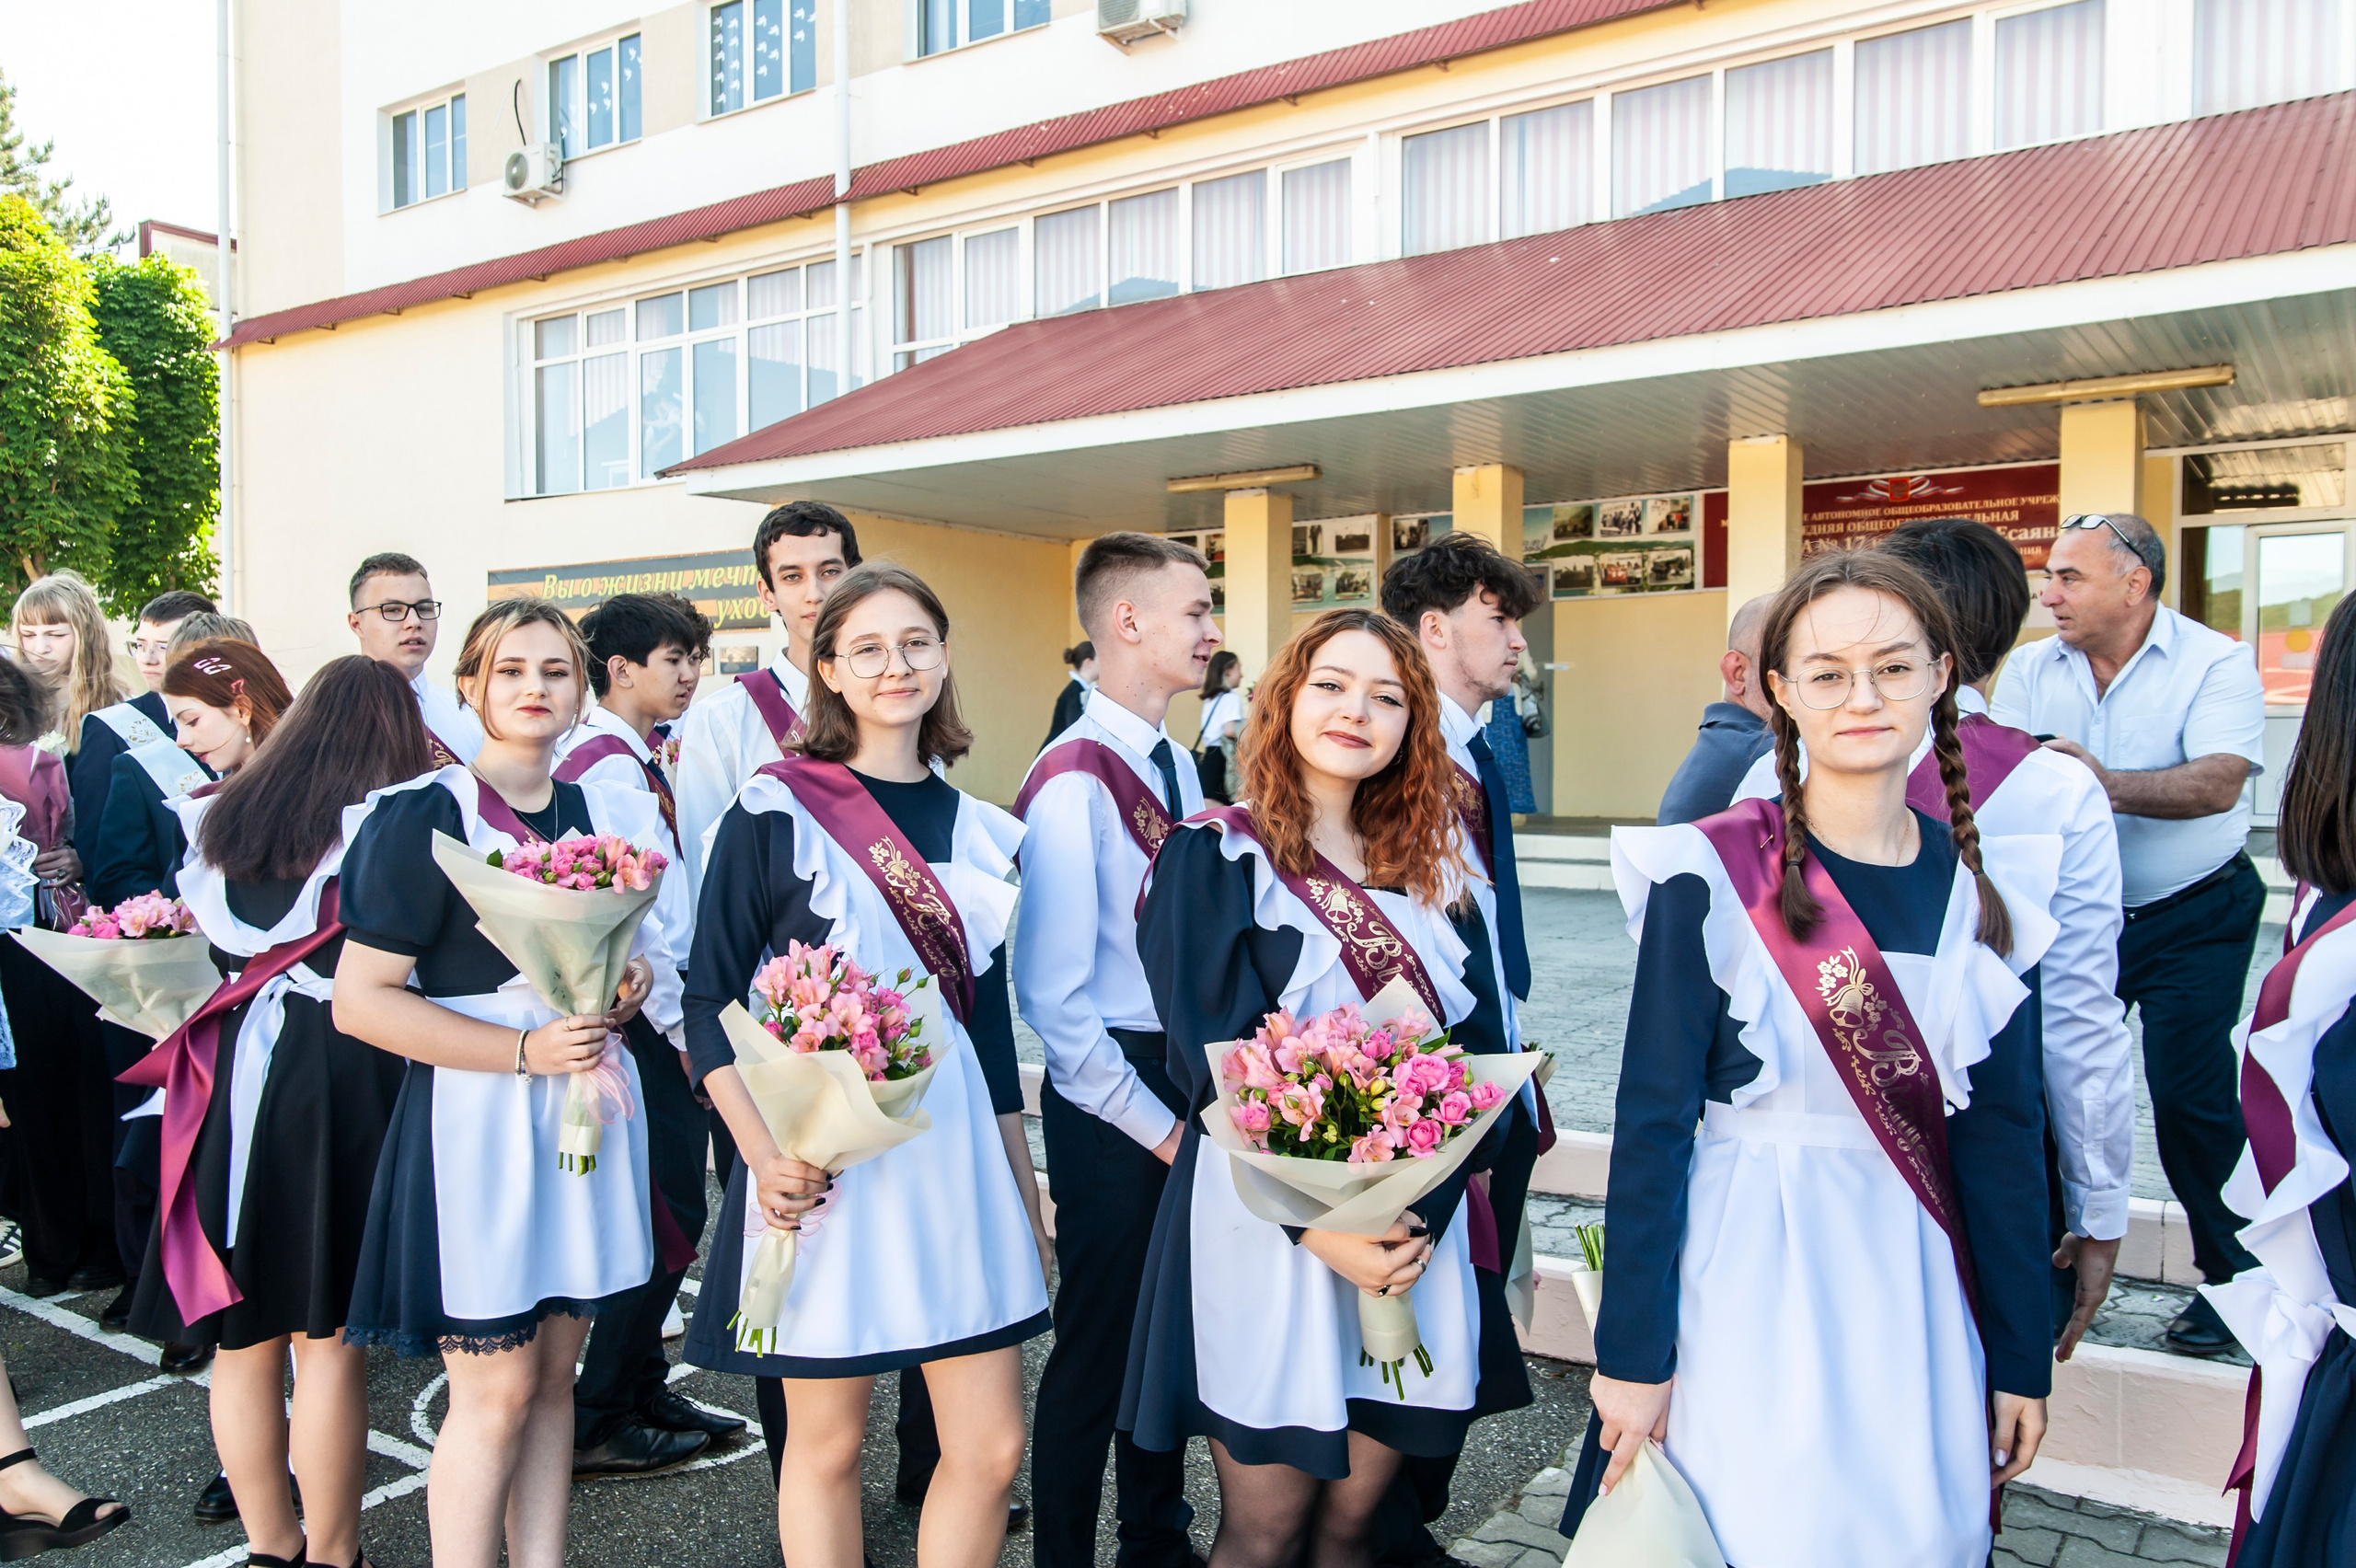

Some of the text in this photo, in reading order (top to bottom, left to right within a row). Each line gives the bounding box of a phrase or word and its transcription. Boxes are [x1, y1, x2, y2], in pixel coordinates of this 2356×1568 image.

[1811, 507, 1880, 521] АВТОНОМНОЕ
[1884, 497, 2018, 516] ОБЩЕОБРАЗОВАТЕЛЬНОЕ
[1843, 535, 1865, 551] 17
[1995, 525, 2060, 541] Есаян
[541, 573, 574, 600] Вы
[580, 577, 594, 597] о
[597, 571, 683, 597] жизни
